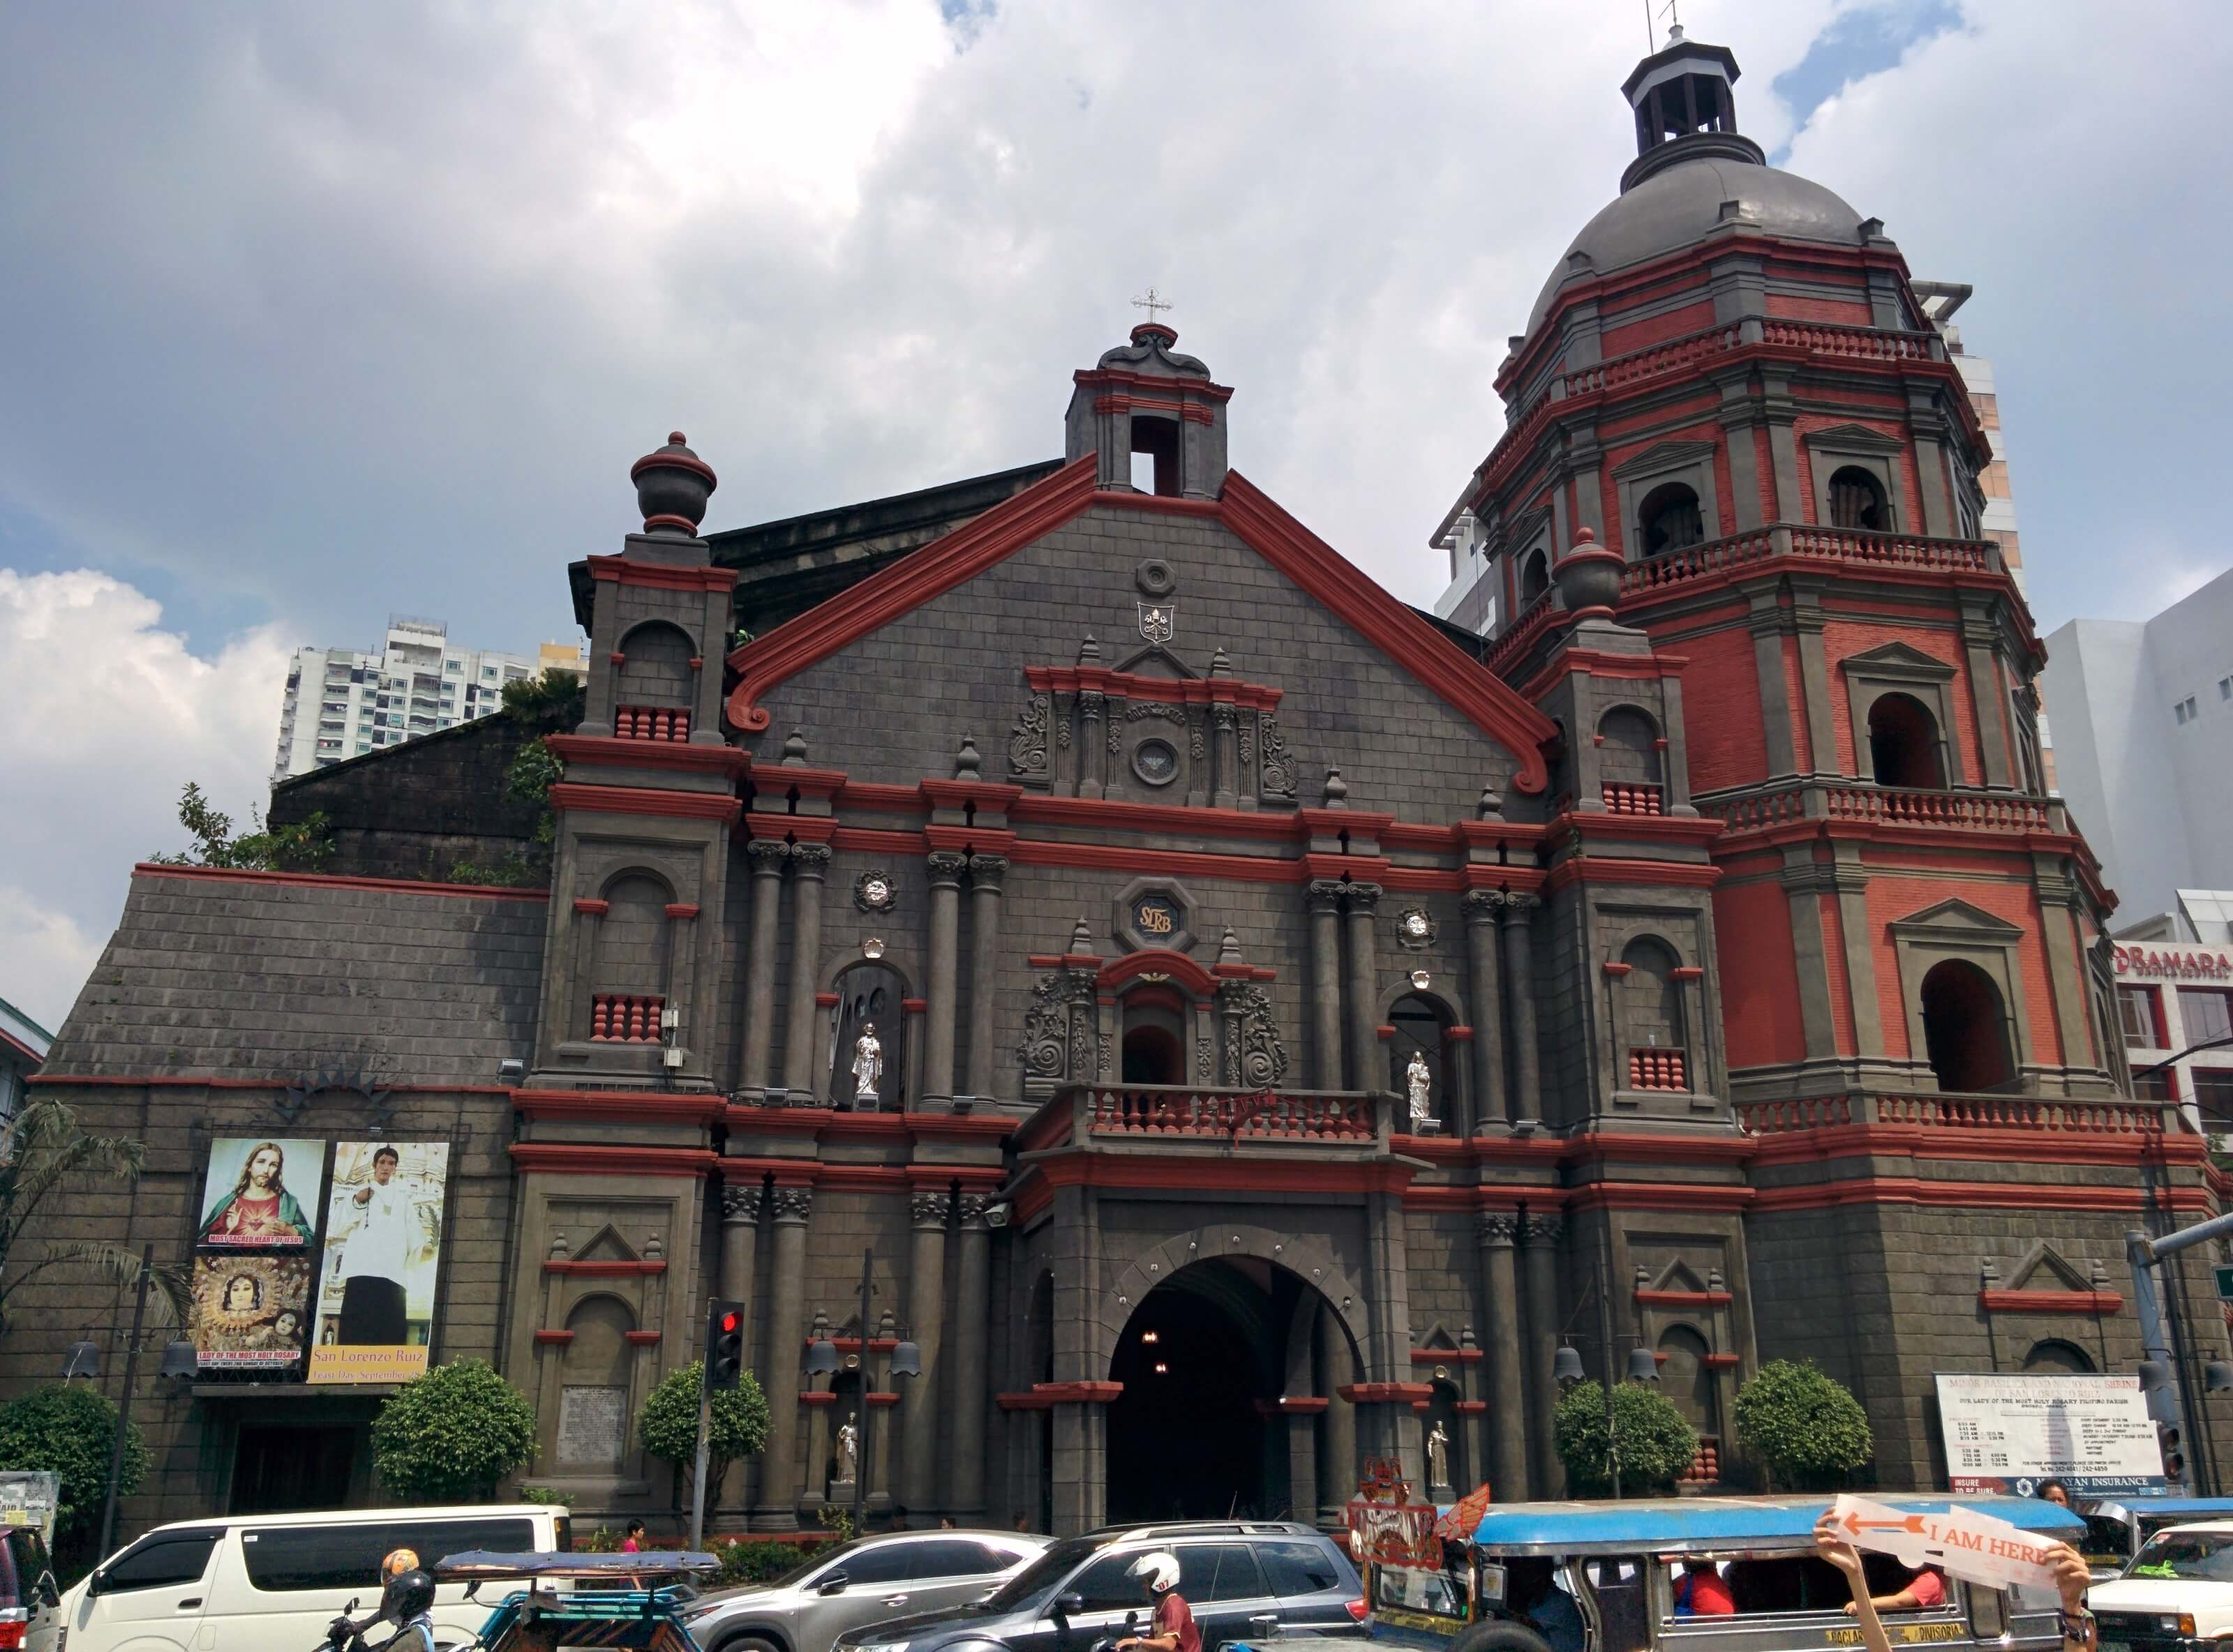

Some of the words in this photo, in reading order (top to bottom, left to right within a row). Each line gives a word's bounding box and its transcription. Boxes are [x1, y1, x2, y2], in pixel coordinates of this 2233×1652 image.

[2130, 947, 2232, 973] RAMADA
[314, 1350, 336, 1362] San
[341, 1350, 391, 1362] Lorenzo
[396, 1349, 424, 1362] Ruiz
[360, 1368, 405, 1381] September
[2104, 1379, 2138, 1388] SHRINE
[2036, 1477, 2089, 1487] MAYAN
[2092, 1477, 2149, 1487] INSURANCE
[1929, 1524, 1938, 1541] I
[1943, 1529, 1984, 1552] AM
[1989, 1538, 2047, 1566] HERE
[1919, 1624, 1959, 1641] DIVISORIA
